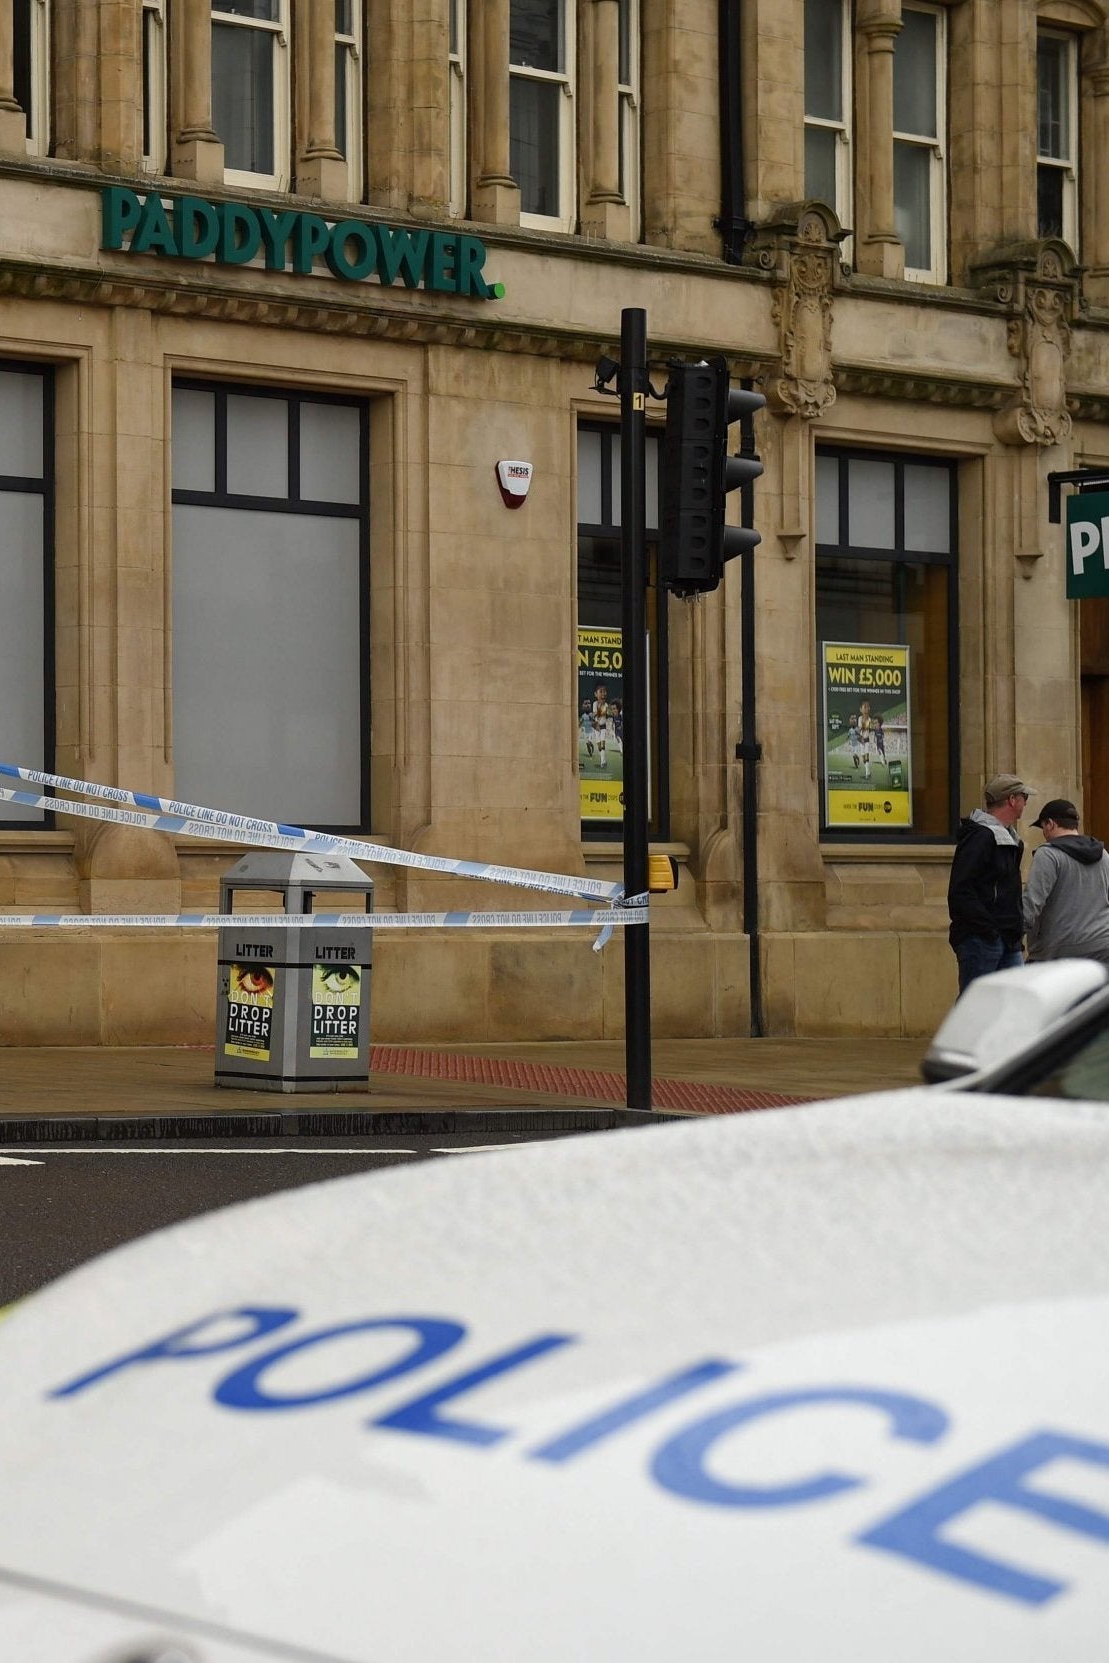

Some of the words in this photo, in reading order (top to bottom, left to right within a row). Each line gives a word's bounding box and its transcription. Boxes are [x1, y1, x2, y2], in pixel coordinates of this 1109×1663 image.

[636, 395, 641, 408] 1
[1070, 516, 1109, 576] P
[851, 654, 864, 662] MAN
[865, 655, 894, 664] STANDING
[828, 667, 856, 684] WIN
[859, 669, 902, 688] £5,000
[28, 771, 53, 786] POLICE
[55, 776, 72, 790] LINE
[74, 781, 85, 793] DO
[86, 784, 101, 796] NOT
[103, 788, 129, 802] CROSS
[590, 793, 608, 803] FUN
[858, 802, 874, 812] FUN
[169, 802, 195, 818] POLICE
[197, 808, 214, 822] LINE
[216, 812, 227, 824] DO
[229, 815, 244, 828] NOT
[246, 819, 273, 833] CROSS
[236, 944, 273, 958] LITTER
[316, 946, 356, 960] LITTER
[315, 992, 358, 1005] DON'T
[230, 1004, 270, 1022] DROP
[314, 1006, 358, 1020] DROP
[229, 1017, 269, 1037] LITTER
[313, 1021, 357, 1035] LITTER
[43, 1306, 1109, 1609] POLICE
